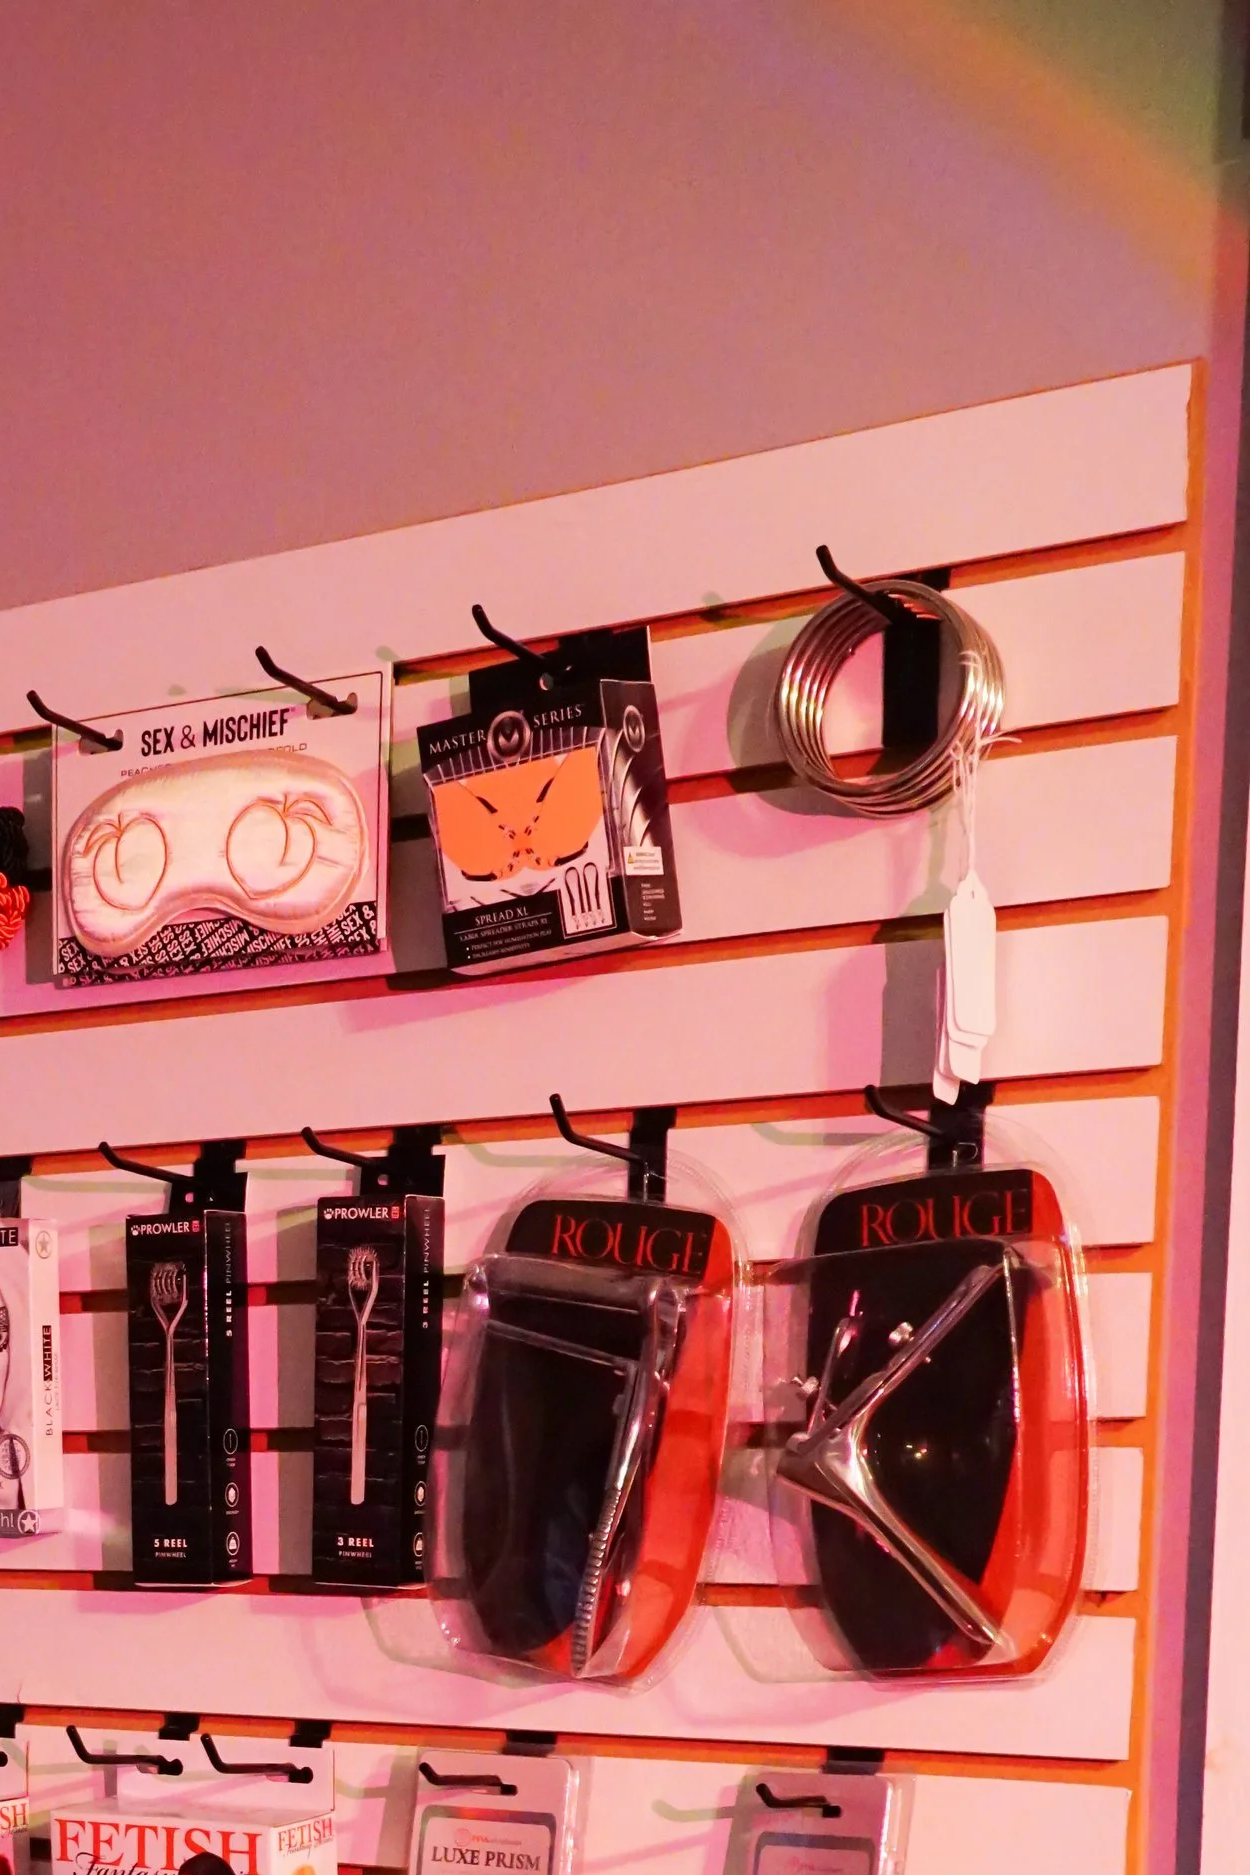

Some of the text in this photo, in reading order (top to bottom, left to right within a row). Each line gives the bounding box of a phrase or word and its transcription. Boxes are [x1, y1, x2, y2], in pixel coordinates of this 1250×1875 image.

[141, 708, 290, 757] SEX & MISCHIEF
[429, 704, 582, 755] MASTER SERIES
[475, 906, 529, 926] SPREAD XL
[334, 1206, 389, 1220] PROWLER
[861, 1190, 1031, 1248] ROUGE
[140, 1222, 190, 1236] PROWLER
[552, 1214, 710, 1275] ROUGE
[43, 1325, 52, 1380] WHITE
[154, 1539, 188, 1549] 5 REEL
[337, 1537, 374, 1549] 3 REEL
[338, 1550, 372, 1558] PINWHEEL
[278, 1816, 333, 1852] FETISH
[431, 1846, 542, 1872] LUXE PRISM
